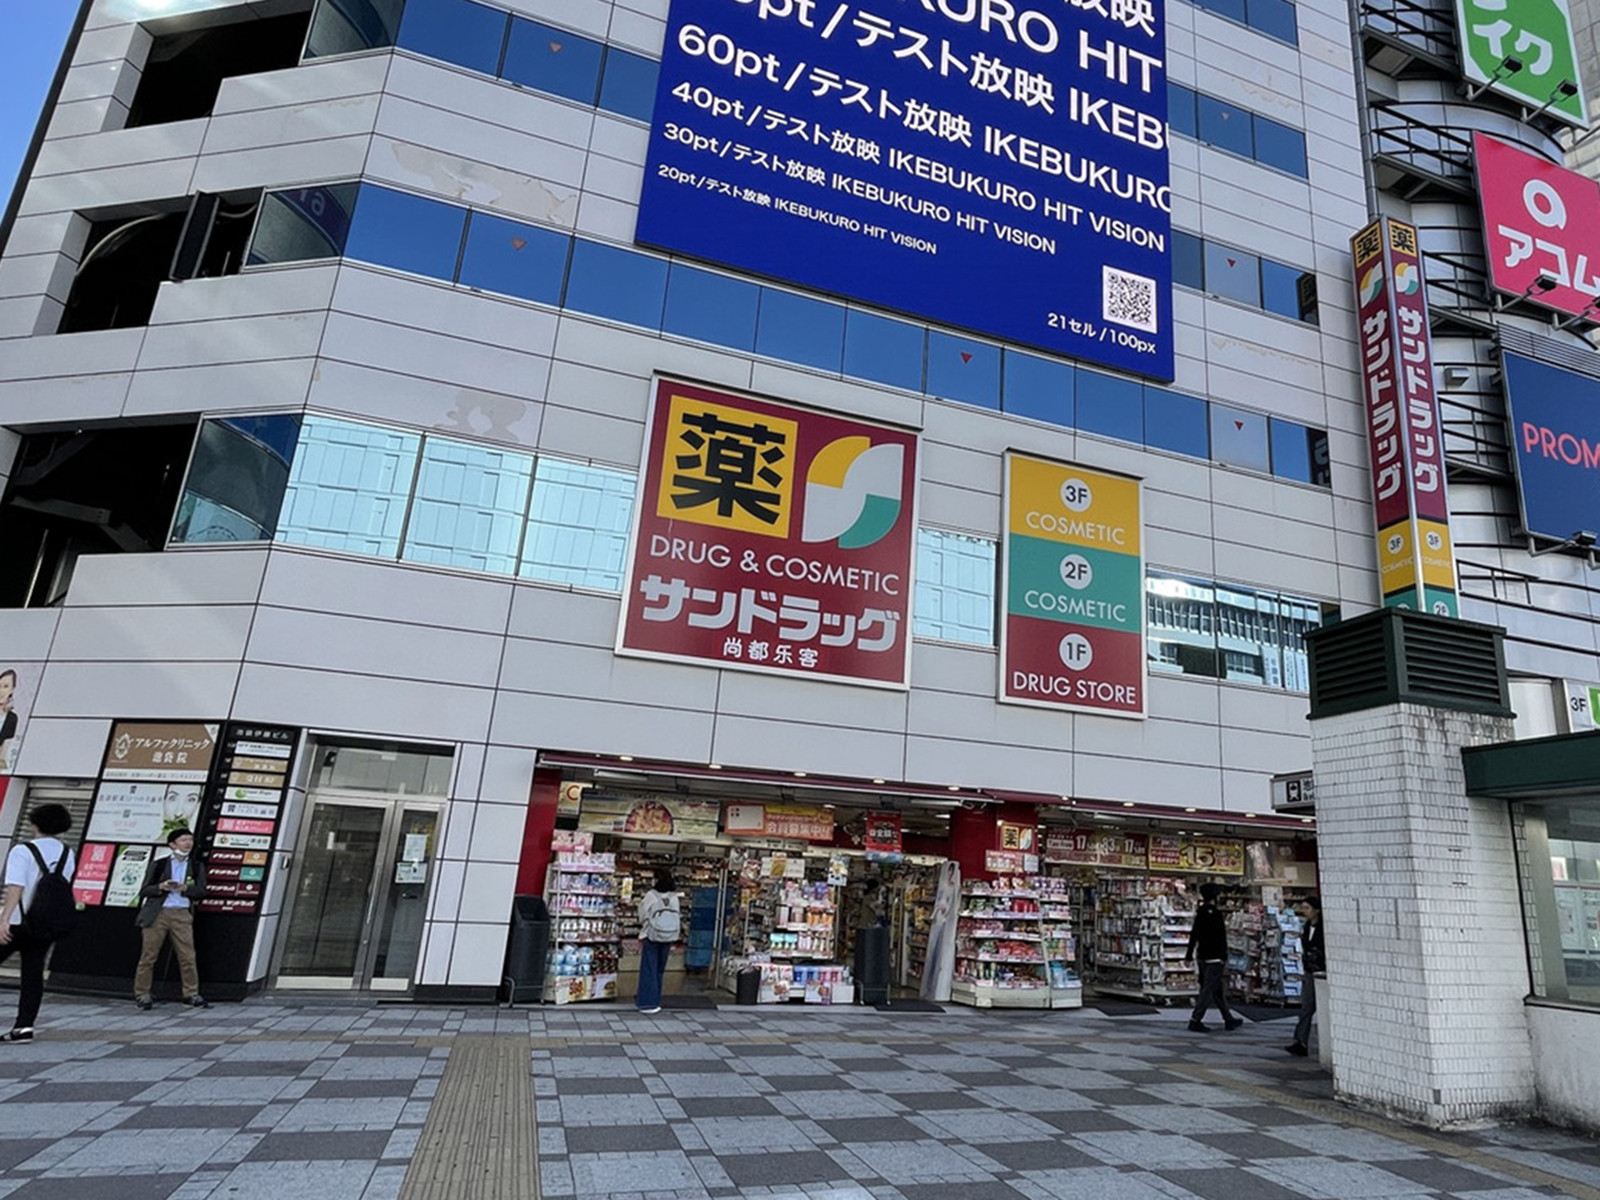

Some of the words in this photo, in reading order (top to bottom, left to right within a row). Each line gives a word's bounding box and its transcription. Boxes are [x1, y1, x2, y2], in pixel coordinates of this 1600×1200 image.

[1078, 29, 1163, 93] HIT
[1472, 0, 1554, 76] イク
[1069, 87, 1170, 150] IKEB
[774, 197, 860, 232] IKEBUKURO
[863, 223, 887, 240] HIT
[889, 231, 937, 255] VISION
[831, 173, 950, 223] IKEBUKURO
[956, 212, 989, 235] HIT
[993, 222, 1056, 255] VISION
[888, 148, 1036, 211] IKEBUKURO
[1044, 198, 1083, 225] HIT
[1089, 211, 1165, 253] VISION
[1357, 229, 1380, 264] 薬
[1391, 221, 1415, 253] 薬
[1363, 309, 1402, 501] サンドラッグ
[1398, 306, 1439, 493] サンドラッグ
[670, 411, 787, 525] 薬
[1064, 484, 1089, 504] 3F
[1025, 511, 1125, 546] COSMETIC
[650, 535, 732, 571] DRUG
[739, 549, 762, 573] &
[765, 555, 899, 597] COSMETIC
[1064, 560, 1089, 581] 2F
[639, 574, 900, 652] サンドラッグ
[1024, 589, 1127, 623] COSMETIC
[1065, 640, 1089, 660] 1F
[1013, 670, 1071, 697] DRUG
[1075, 680, 1136, 705] STORE
[1570, 696, 1586, 712] 3F
[1180, 843, 1216, 868] 15
